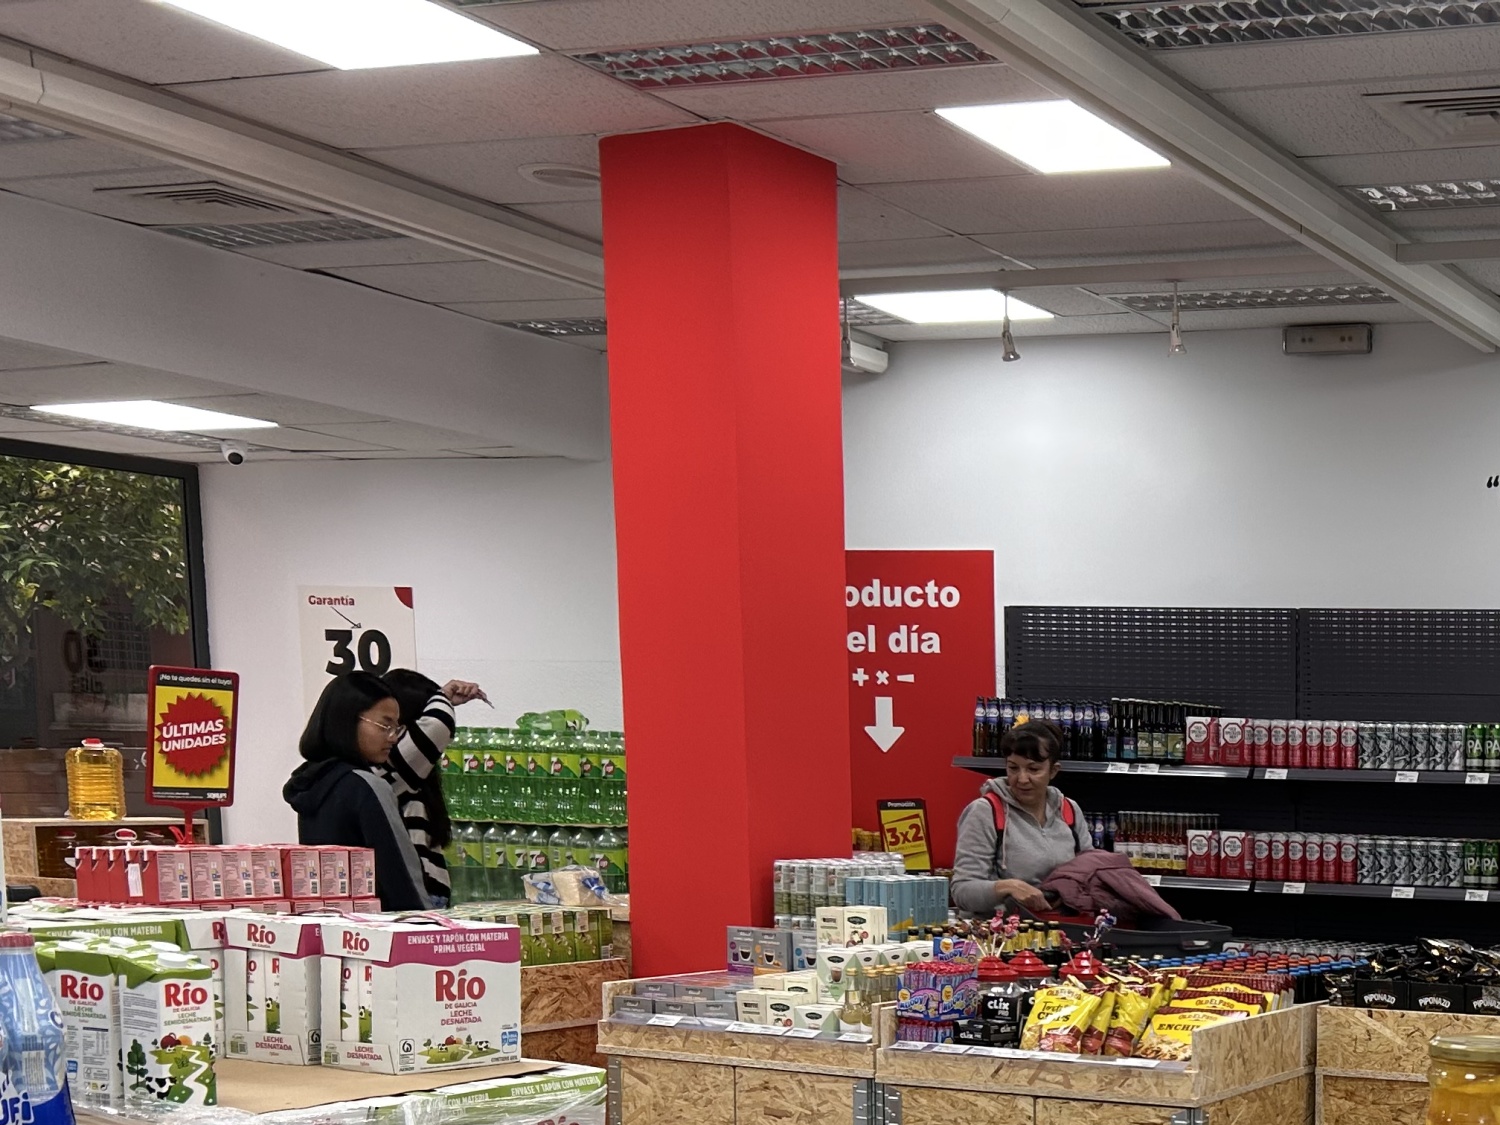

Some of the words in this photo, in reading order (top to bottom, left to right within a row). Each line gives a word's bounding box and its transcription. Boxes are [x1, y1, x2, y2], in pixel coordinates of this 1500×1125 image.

[309, 595, 355, 606] Garantía
[846, 579, 960, 608] oducto
[847, 625, 875, 653] el
[889, 625, 941, 653] día
[325, 629, 391, 677] 30
[162, 719, 223, 738] ÚLTIMAS
[163, 734, 227, 752] UNIDADES
[886, 823, 924, 846] 3x2
[408, 935, 435, 945] ENVASE
[437, 935, 441, 943] Y
[443, 932, 464, 943] TAPÓN
[466, 933, 479, 942] CON
[481, 932, 509, 942] MATERIA
[434, 944, 455, 953] PRIMA
[457, 943, 485, 952] VEGETAL
[60, 975, 104, 1001] Río
[435, 968, 486, 1002] Río
[165, 983, 208, 1007] Río
[1363, 994, 1396, 1006] PIPONAZO
[1418, 997, 1451, 1009] PIPONAZO
[441, 1016, 482, 1026] DESNATADA
[450, 1010, 473, 1018] LECHE
[255, 1042, 292, 1052] DESNATADA
